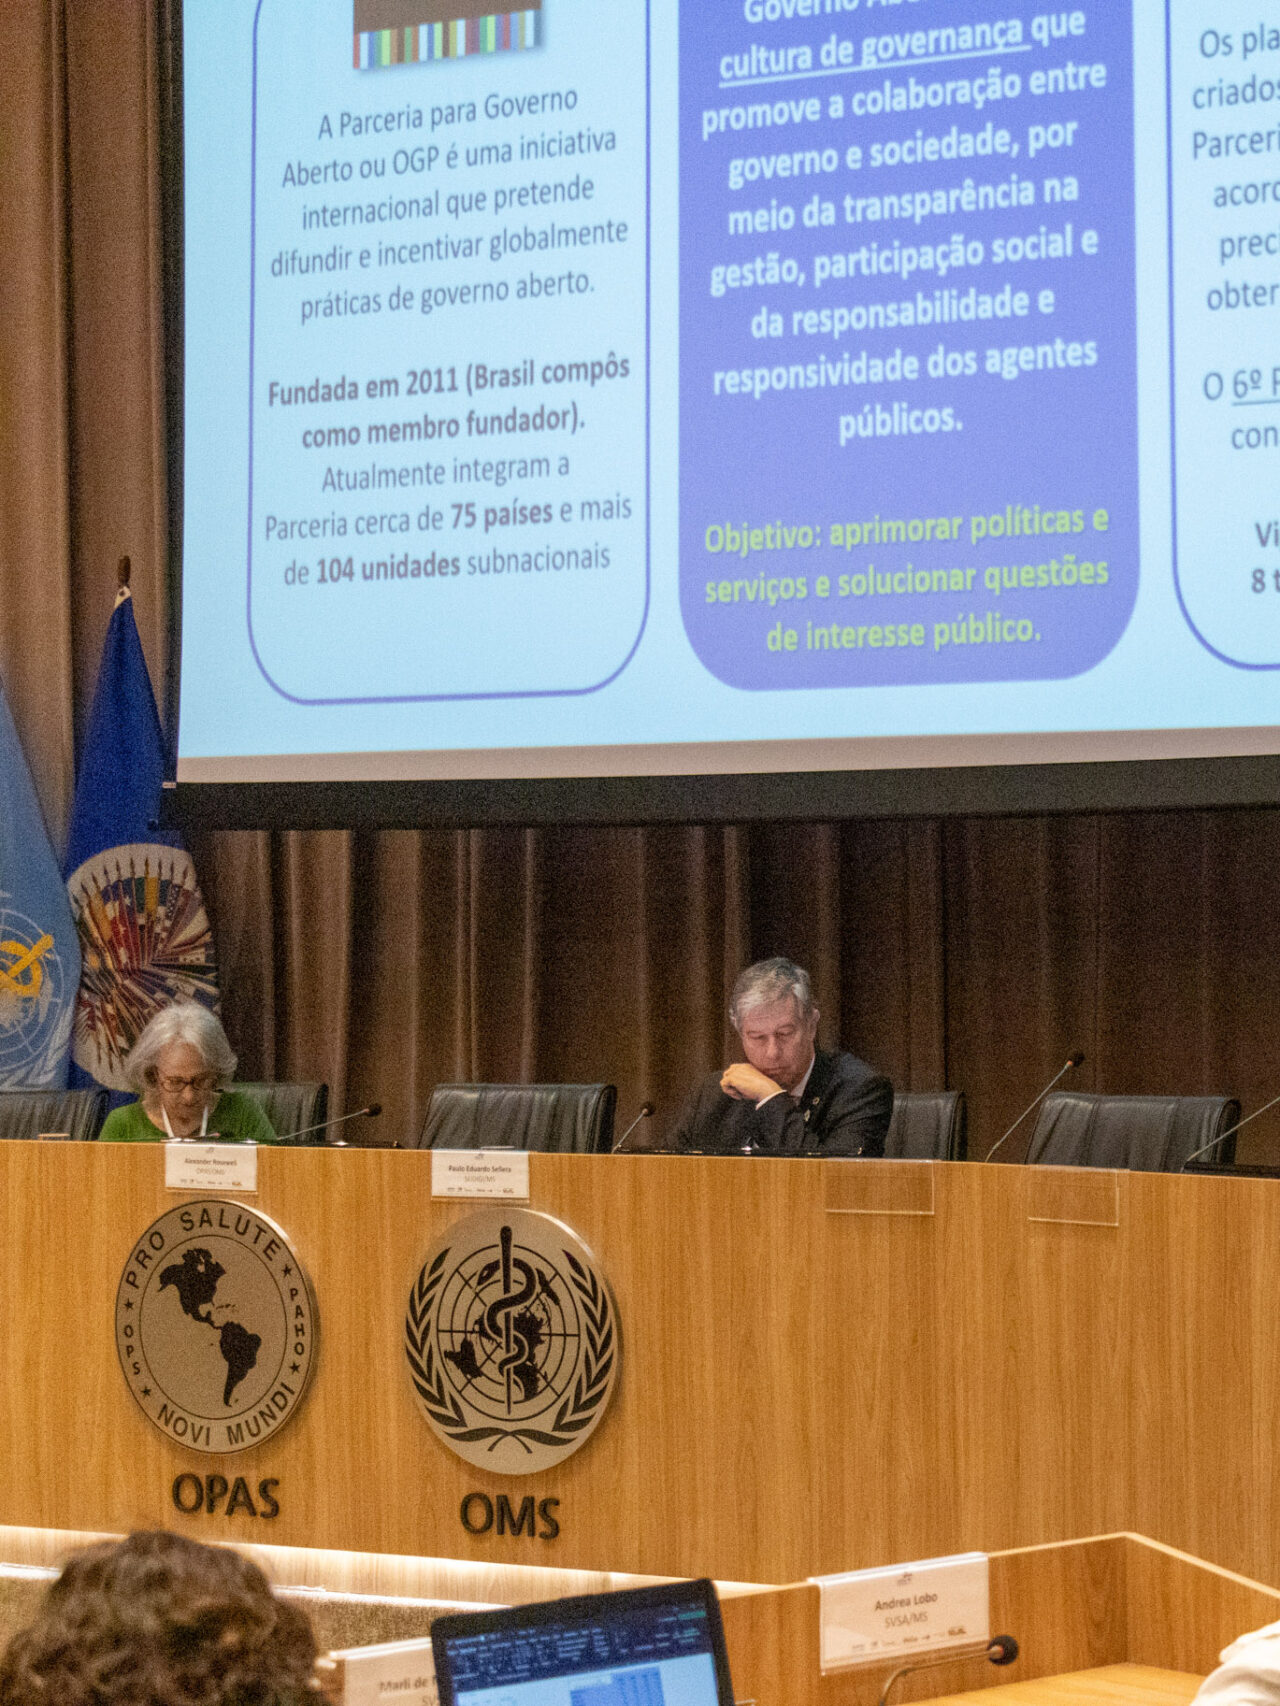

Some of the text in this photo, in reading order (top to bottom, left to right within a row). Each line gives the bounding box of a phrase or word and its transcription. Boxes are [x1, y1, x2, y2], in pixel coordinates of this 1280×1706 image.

[720, 10, 1086, 80] cultura de governança que
[318, 89, 578, 140] A Parceria para Governo
[702, 61, 1107, 141] promove a colaboração entre
[282, 127, 616, 188] Aberto ou OGP é uma iniciativa
[728, 121, 1079, 190] governo e sociedade, por
[303, 173, 595, 230] internacional que pretende
[728, 173, 1079, 235] meio da transparência na
[271, 219, 628, 277] difundir e incentivar globalmente
[710, 222, 1099, 297] gestão, participação social e
[301, 271, 595, 326] práticas de governo aberto.
[751, 284, 1055, 339] da responsabilidade e
[1206, 280, 1280, 311] obter
[269, 350, 630, 407] Fundada em 2011 (Brasil compôs
[714, 338, 1098, 399] responsividade dos agentes
[1202, 371, 1224, 401] O
[1232, 368, 1262, 401] 6º
[302, 400, 585, 449] como membro fundador).
[266, 492, 632, 540] Parceria cerca de 75 países e mais
[706, 505, 1108, 557] Objetivo: aprimorar políticas e
[284, 542, 610, 586] de 104 unidades subnacionais
[706, 555, 1108, 605] serviços e solucionar questões
[1250, 567, 1267, 594] 8
[767, 613, 1040, 650] de interesse público.
[126, 1208, 280, 1288] PRO SALUTE
[290, 1288, 305, 1355] PAHO
[124, 1325, 141, 1375] OPS
[158, 1382, 295, 1446] NOVI MUNDI
[172, 1473, 280, 1518] OPAS
[460, 1492, 560, 1540] OMS
[875, 1592, 938, 1611] Andrea Lobo
